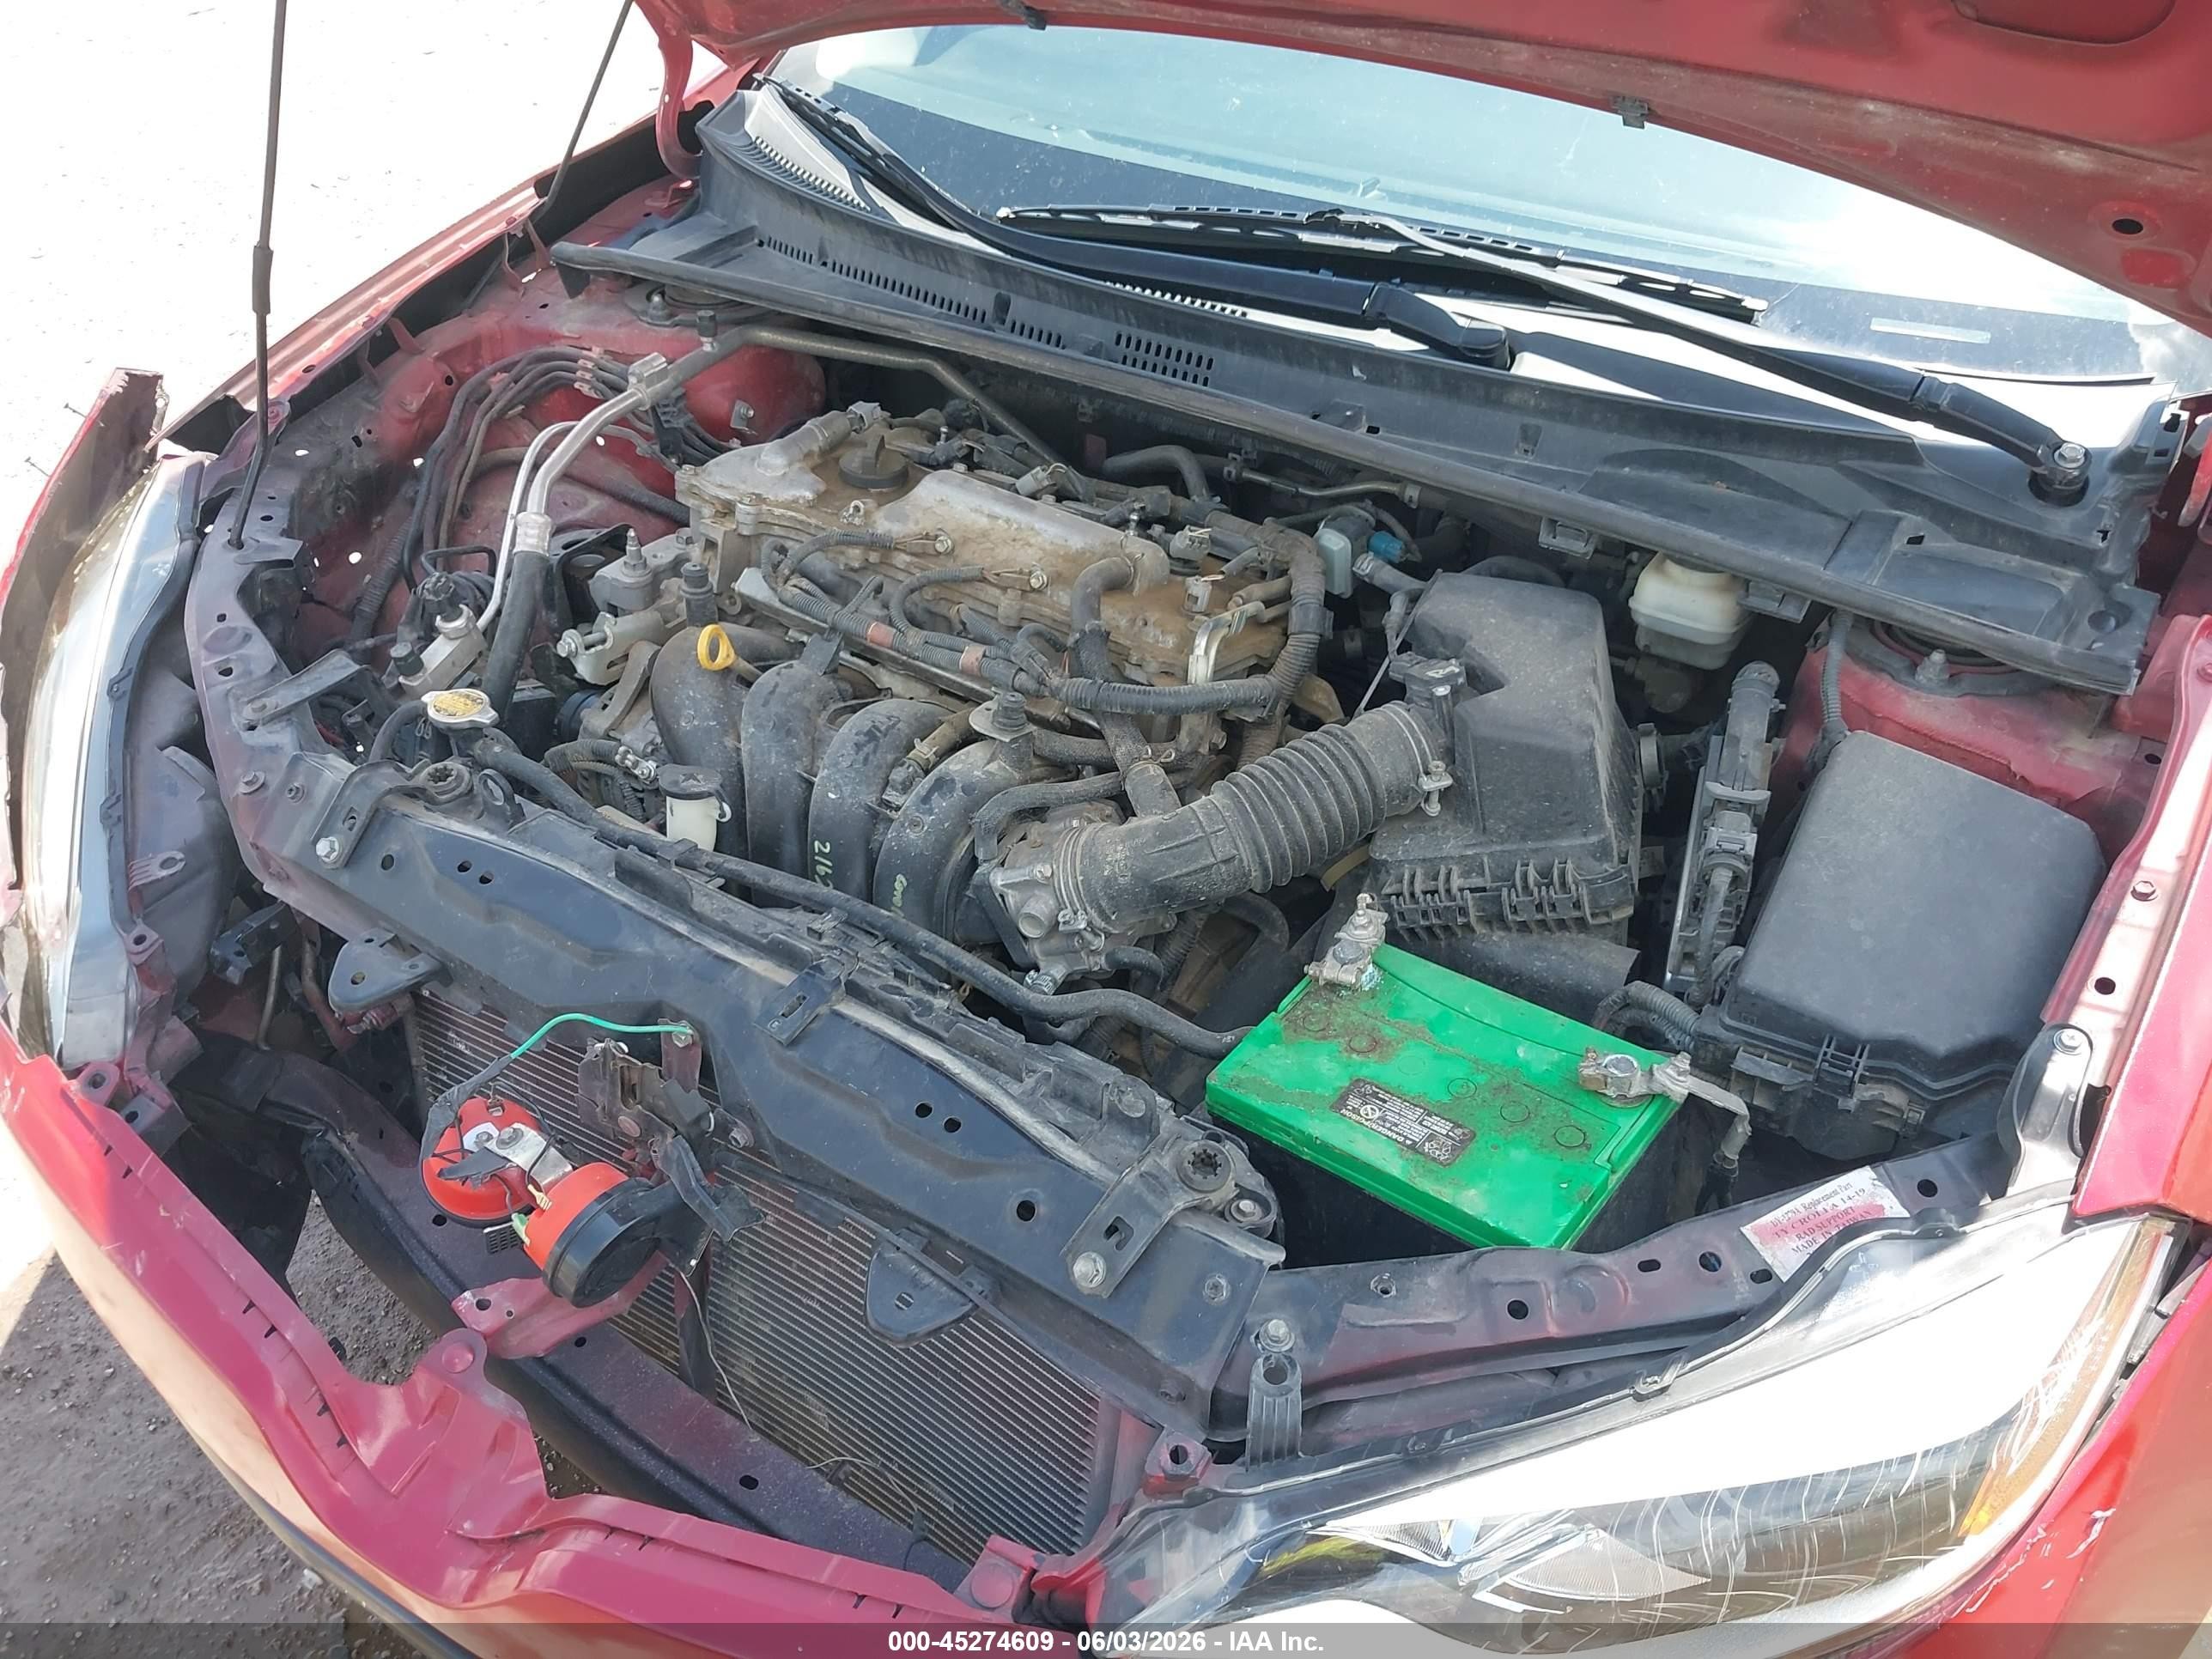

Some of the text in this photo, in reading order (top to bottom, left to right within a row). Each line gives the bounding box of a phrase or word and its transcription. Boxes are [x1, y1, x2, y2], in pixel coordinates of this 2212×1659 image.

[1801, 1188, 1839, 1212] Replacement
[1837, 1182, 1854, 1195] Part
[1840, 1187, 1866, 1204] 14-19
[1796, 1206, 1856, 1242] RAD SUPPORT
[1790, 1236, 1820, 1255] MADE
[1820, 1229, 1833, 1240] IN
